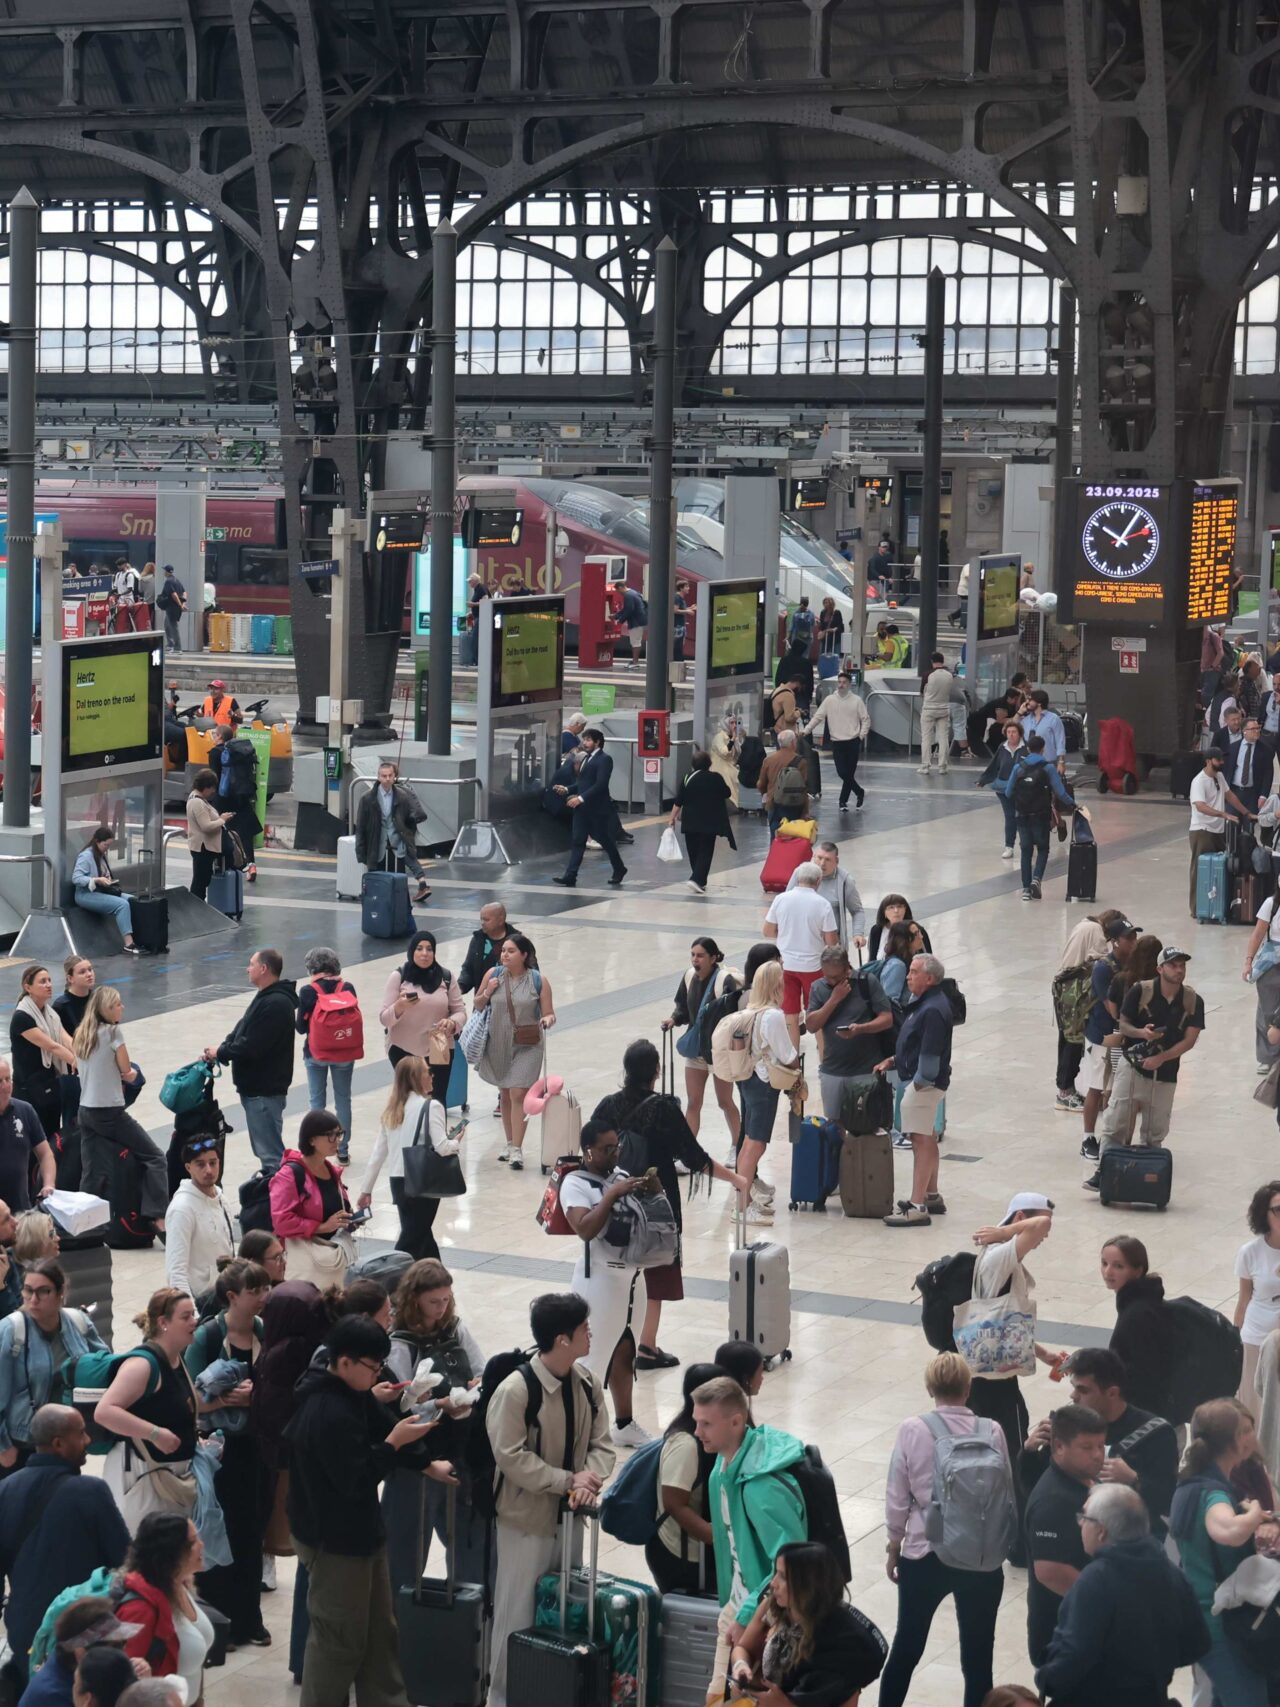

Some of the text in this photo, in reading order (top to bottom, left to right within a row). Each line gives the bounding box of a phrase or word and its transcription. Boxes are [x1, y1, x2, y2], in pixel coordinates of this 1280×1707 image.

[1086, 487, 1159, 498] 23.09.2025
[76, 672, 96, 684] Hertz
[87, 698, 102, 708] treno
[103, 698, 111, 706] on
[112, 695, 122, 705] the
[122, 693, 136, 703] road
